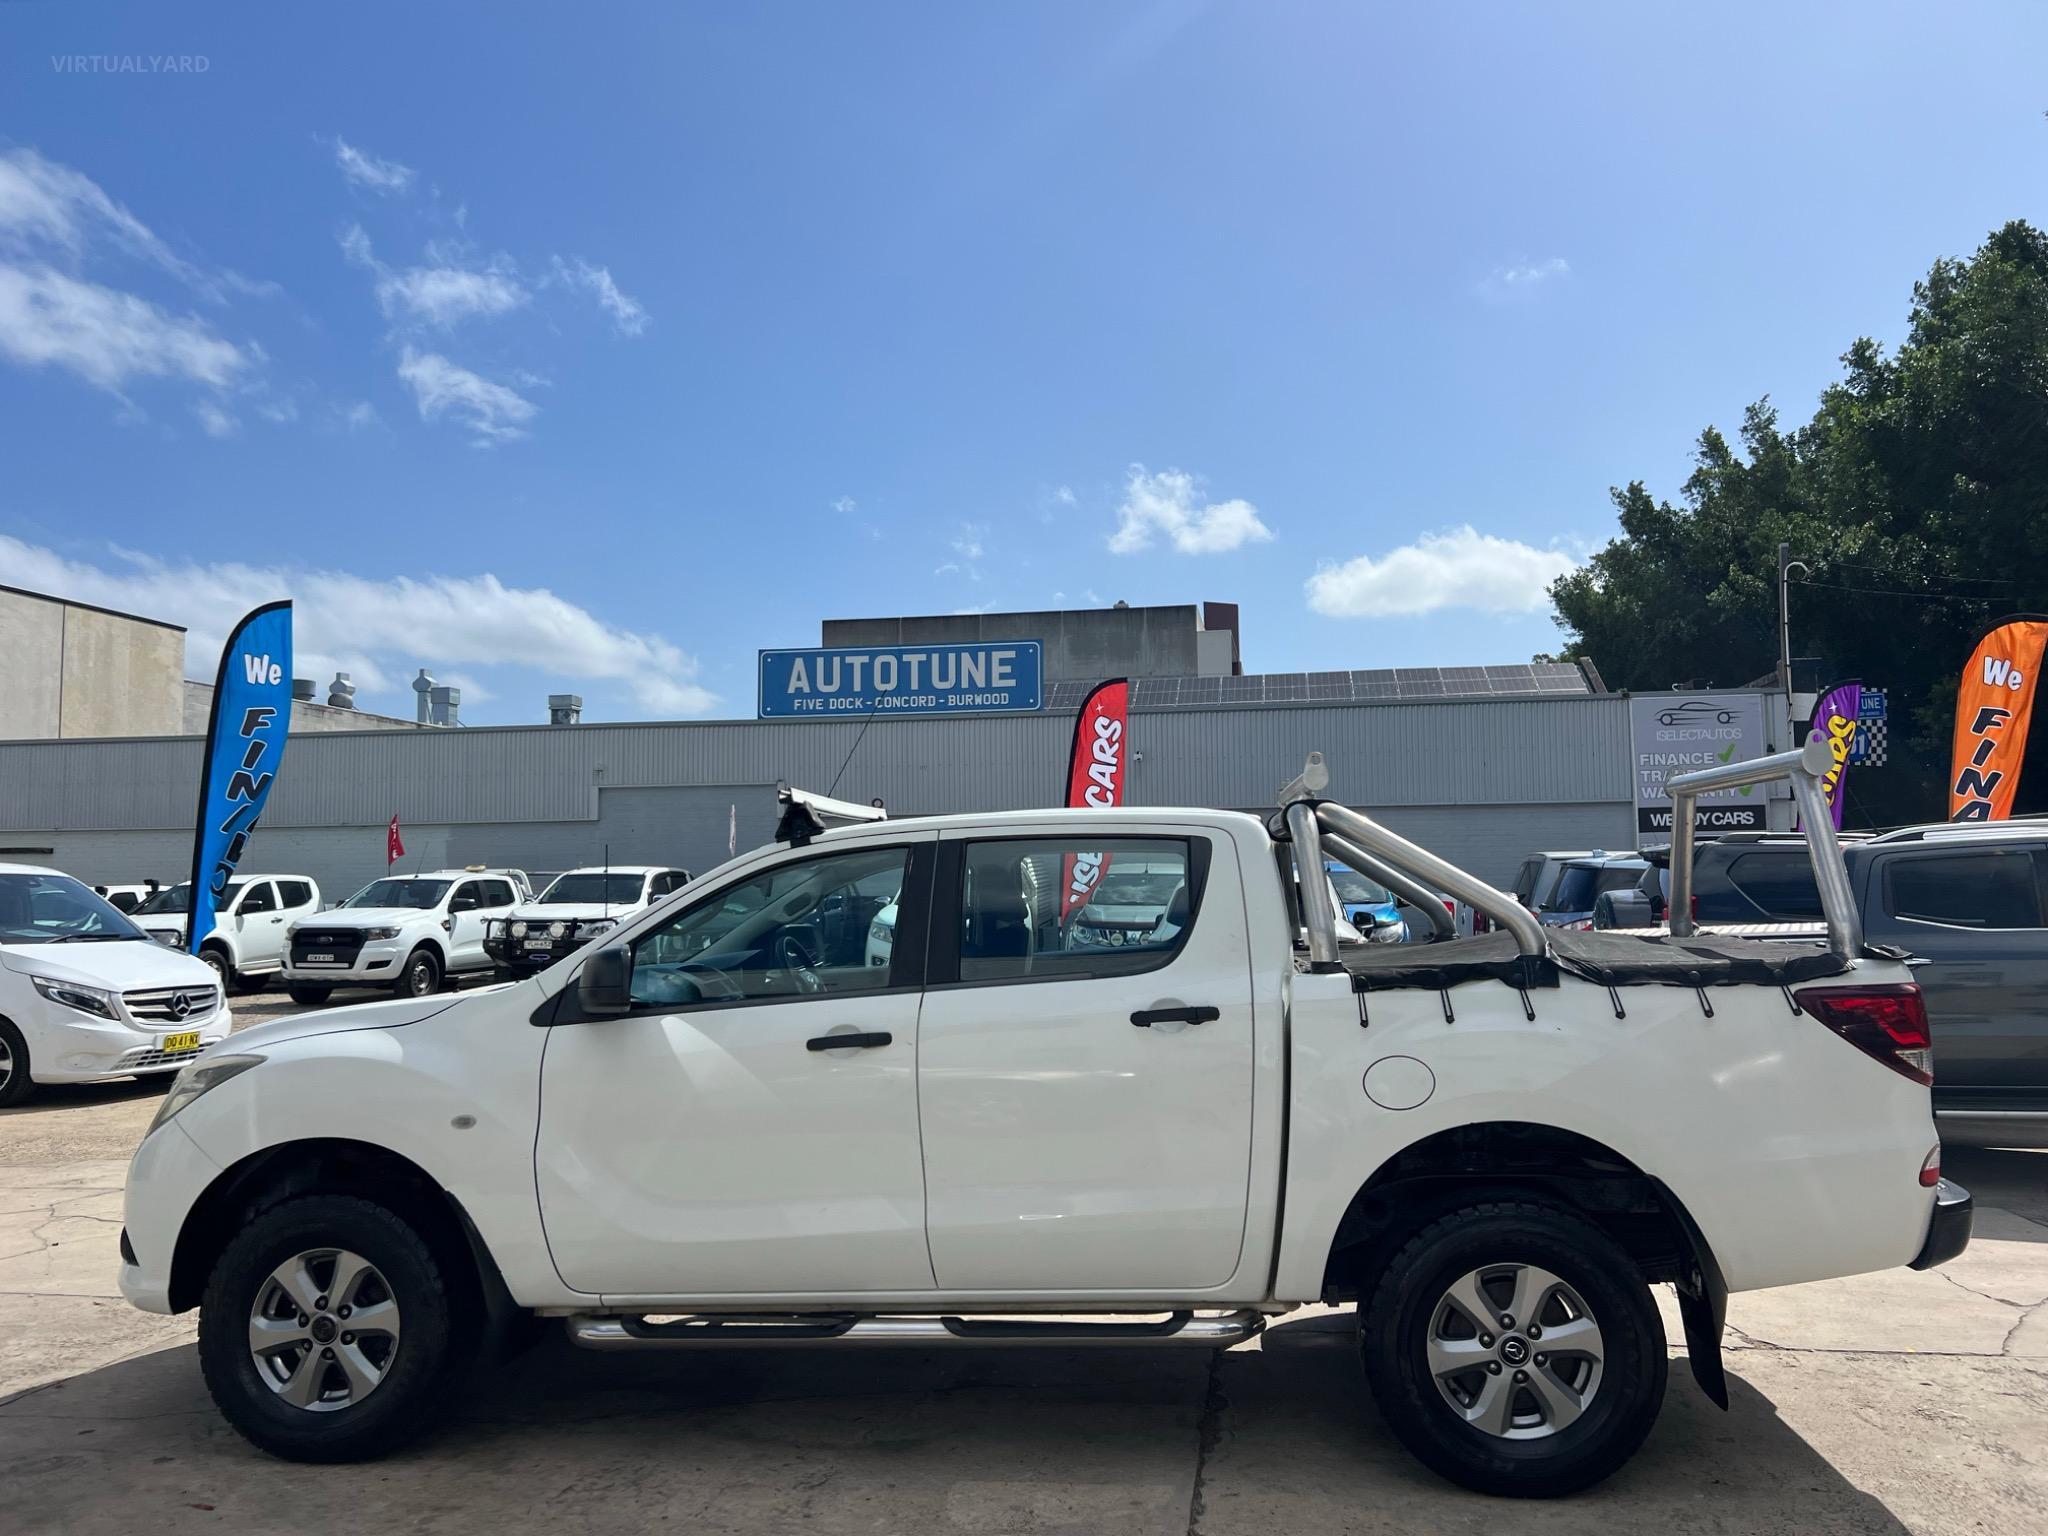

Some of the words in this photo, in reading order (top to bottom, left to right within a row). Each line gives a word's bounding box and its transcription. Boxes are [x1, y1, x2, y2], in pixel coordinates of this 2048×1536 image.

[244, 653, 283, 686] We
[787, 650, 1017, 694] AUTOTUNE
[1983, 656, 2024, 691] We
[793, 698, 824, 711] FIVE
[1084, 715, 1122, 808] CARS
[1639, 751, 1715, 767] FINANCE
[1641, 786, 1737, 799] WANTY
[1711, 811, 1755, 826] CARS
